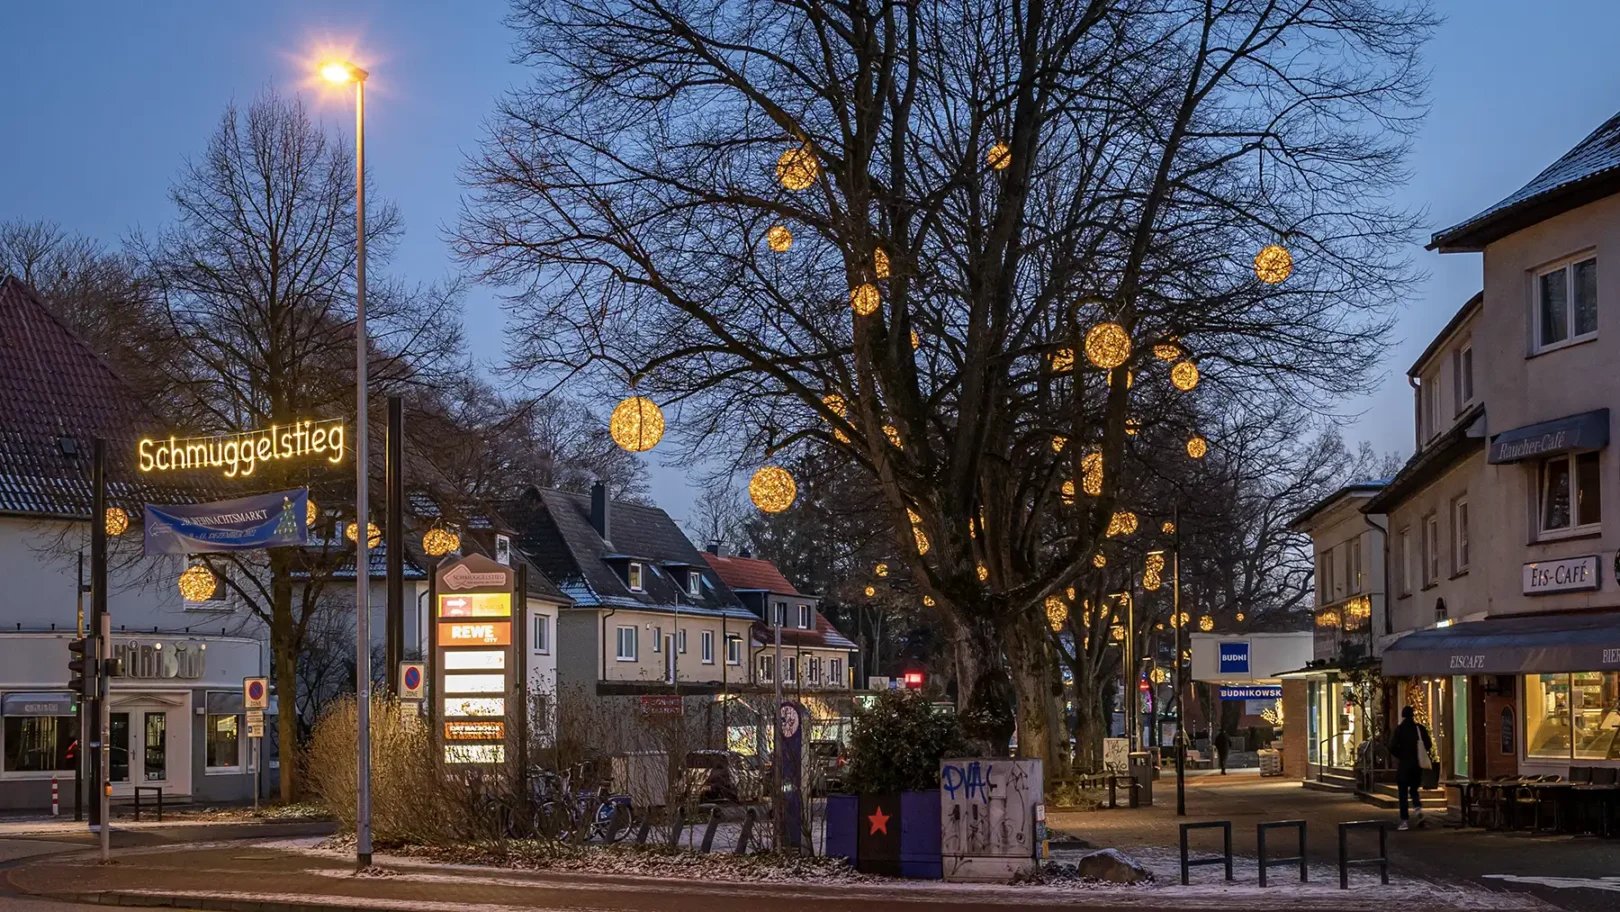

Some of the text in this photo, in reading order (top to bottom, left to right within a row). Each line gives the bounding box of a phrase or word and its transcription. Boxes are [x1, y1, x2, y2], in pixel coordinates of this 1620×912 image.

[139, 421, 344, 477] Schmuggelstieg
[1498, 431, 1566, 460] Raucher-Café
[191, 509, 267, 526] WEIHNACHTSMARKT
[451, 625, 494, 639] REWE
